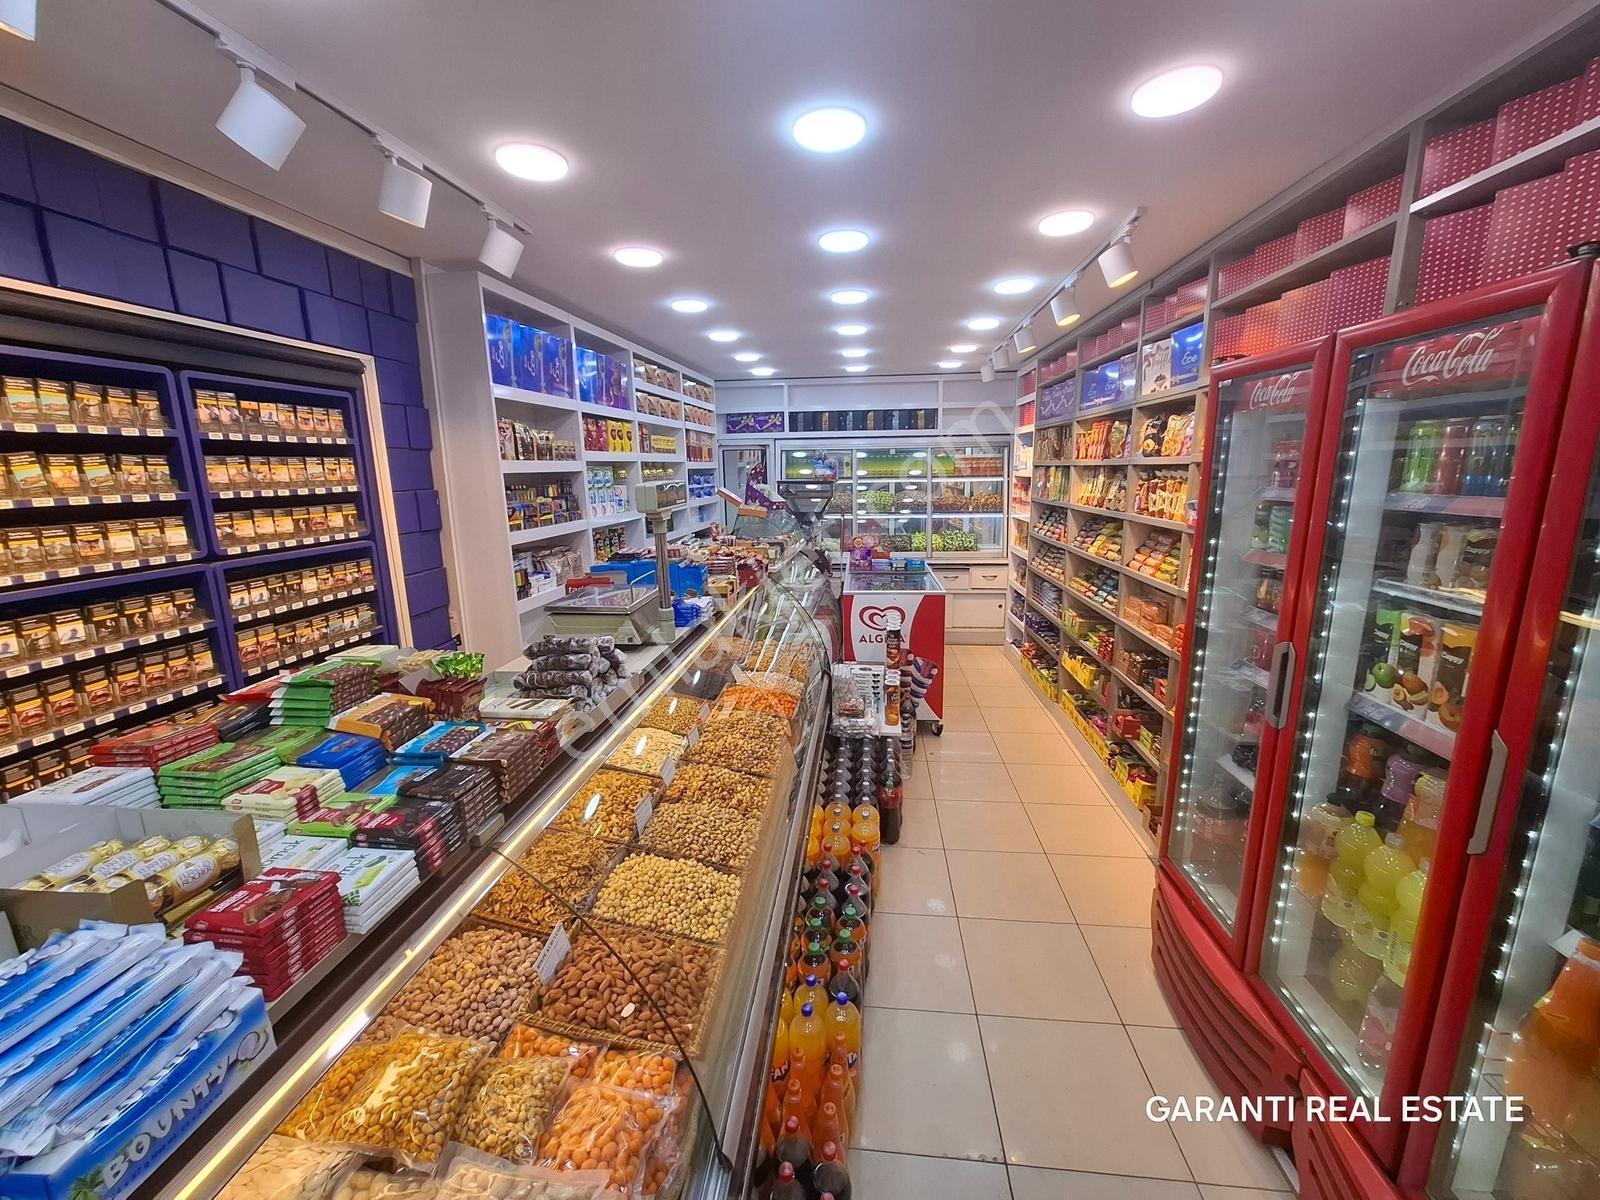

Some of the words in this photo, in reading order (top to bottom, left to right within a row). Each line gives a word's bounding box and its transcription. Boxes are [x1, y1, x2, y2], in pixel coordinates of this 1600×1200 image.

[1402, 327, 1504, 386] Coca-Cola
[1250, 372, 1300, 409] Coca-Cola
[859, 634, 906, 643] ALGIA
[104, 1056, 230, 1189] BOUNTY
